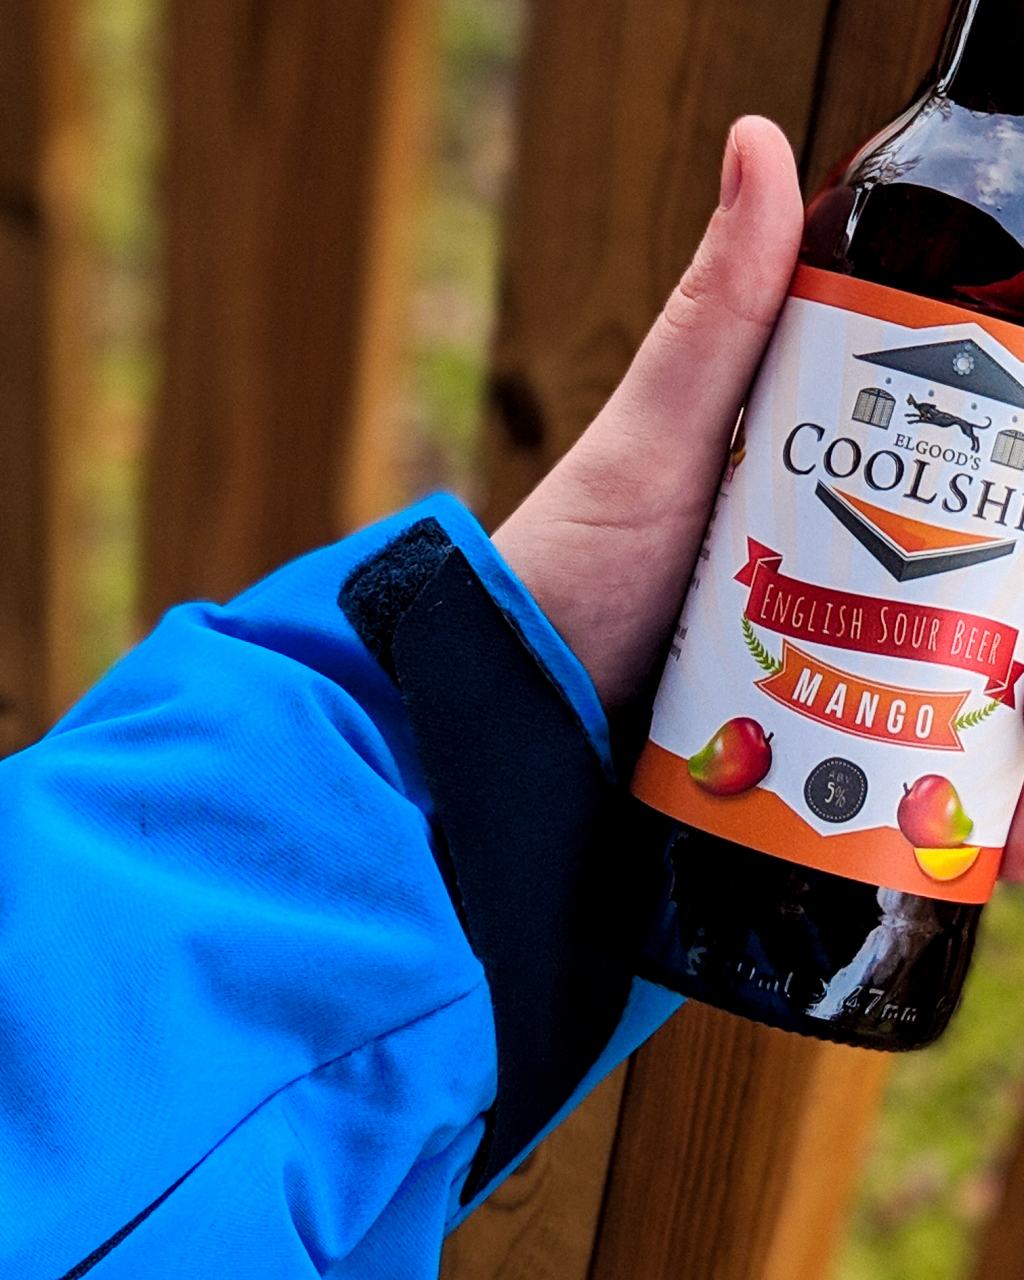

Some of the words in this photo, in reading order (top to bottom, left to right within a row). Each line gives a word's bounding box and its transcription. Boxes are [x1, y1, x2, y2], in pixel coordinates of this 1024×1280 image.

[893, 433, 982, 471] ELGOOD'S
[760, 583, 863, 640] ENGLISH
[877, 606, 940, 652] SOUR
[951, 619, 1001, 665] BEER
[791, 667, 934, 739] MANGO
[824, 781, 846, 808] 5%
